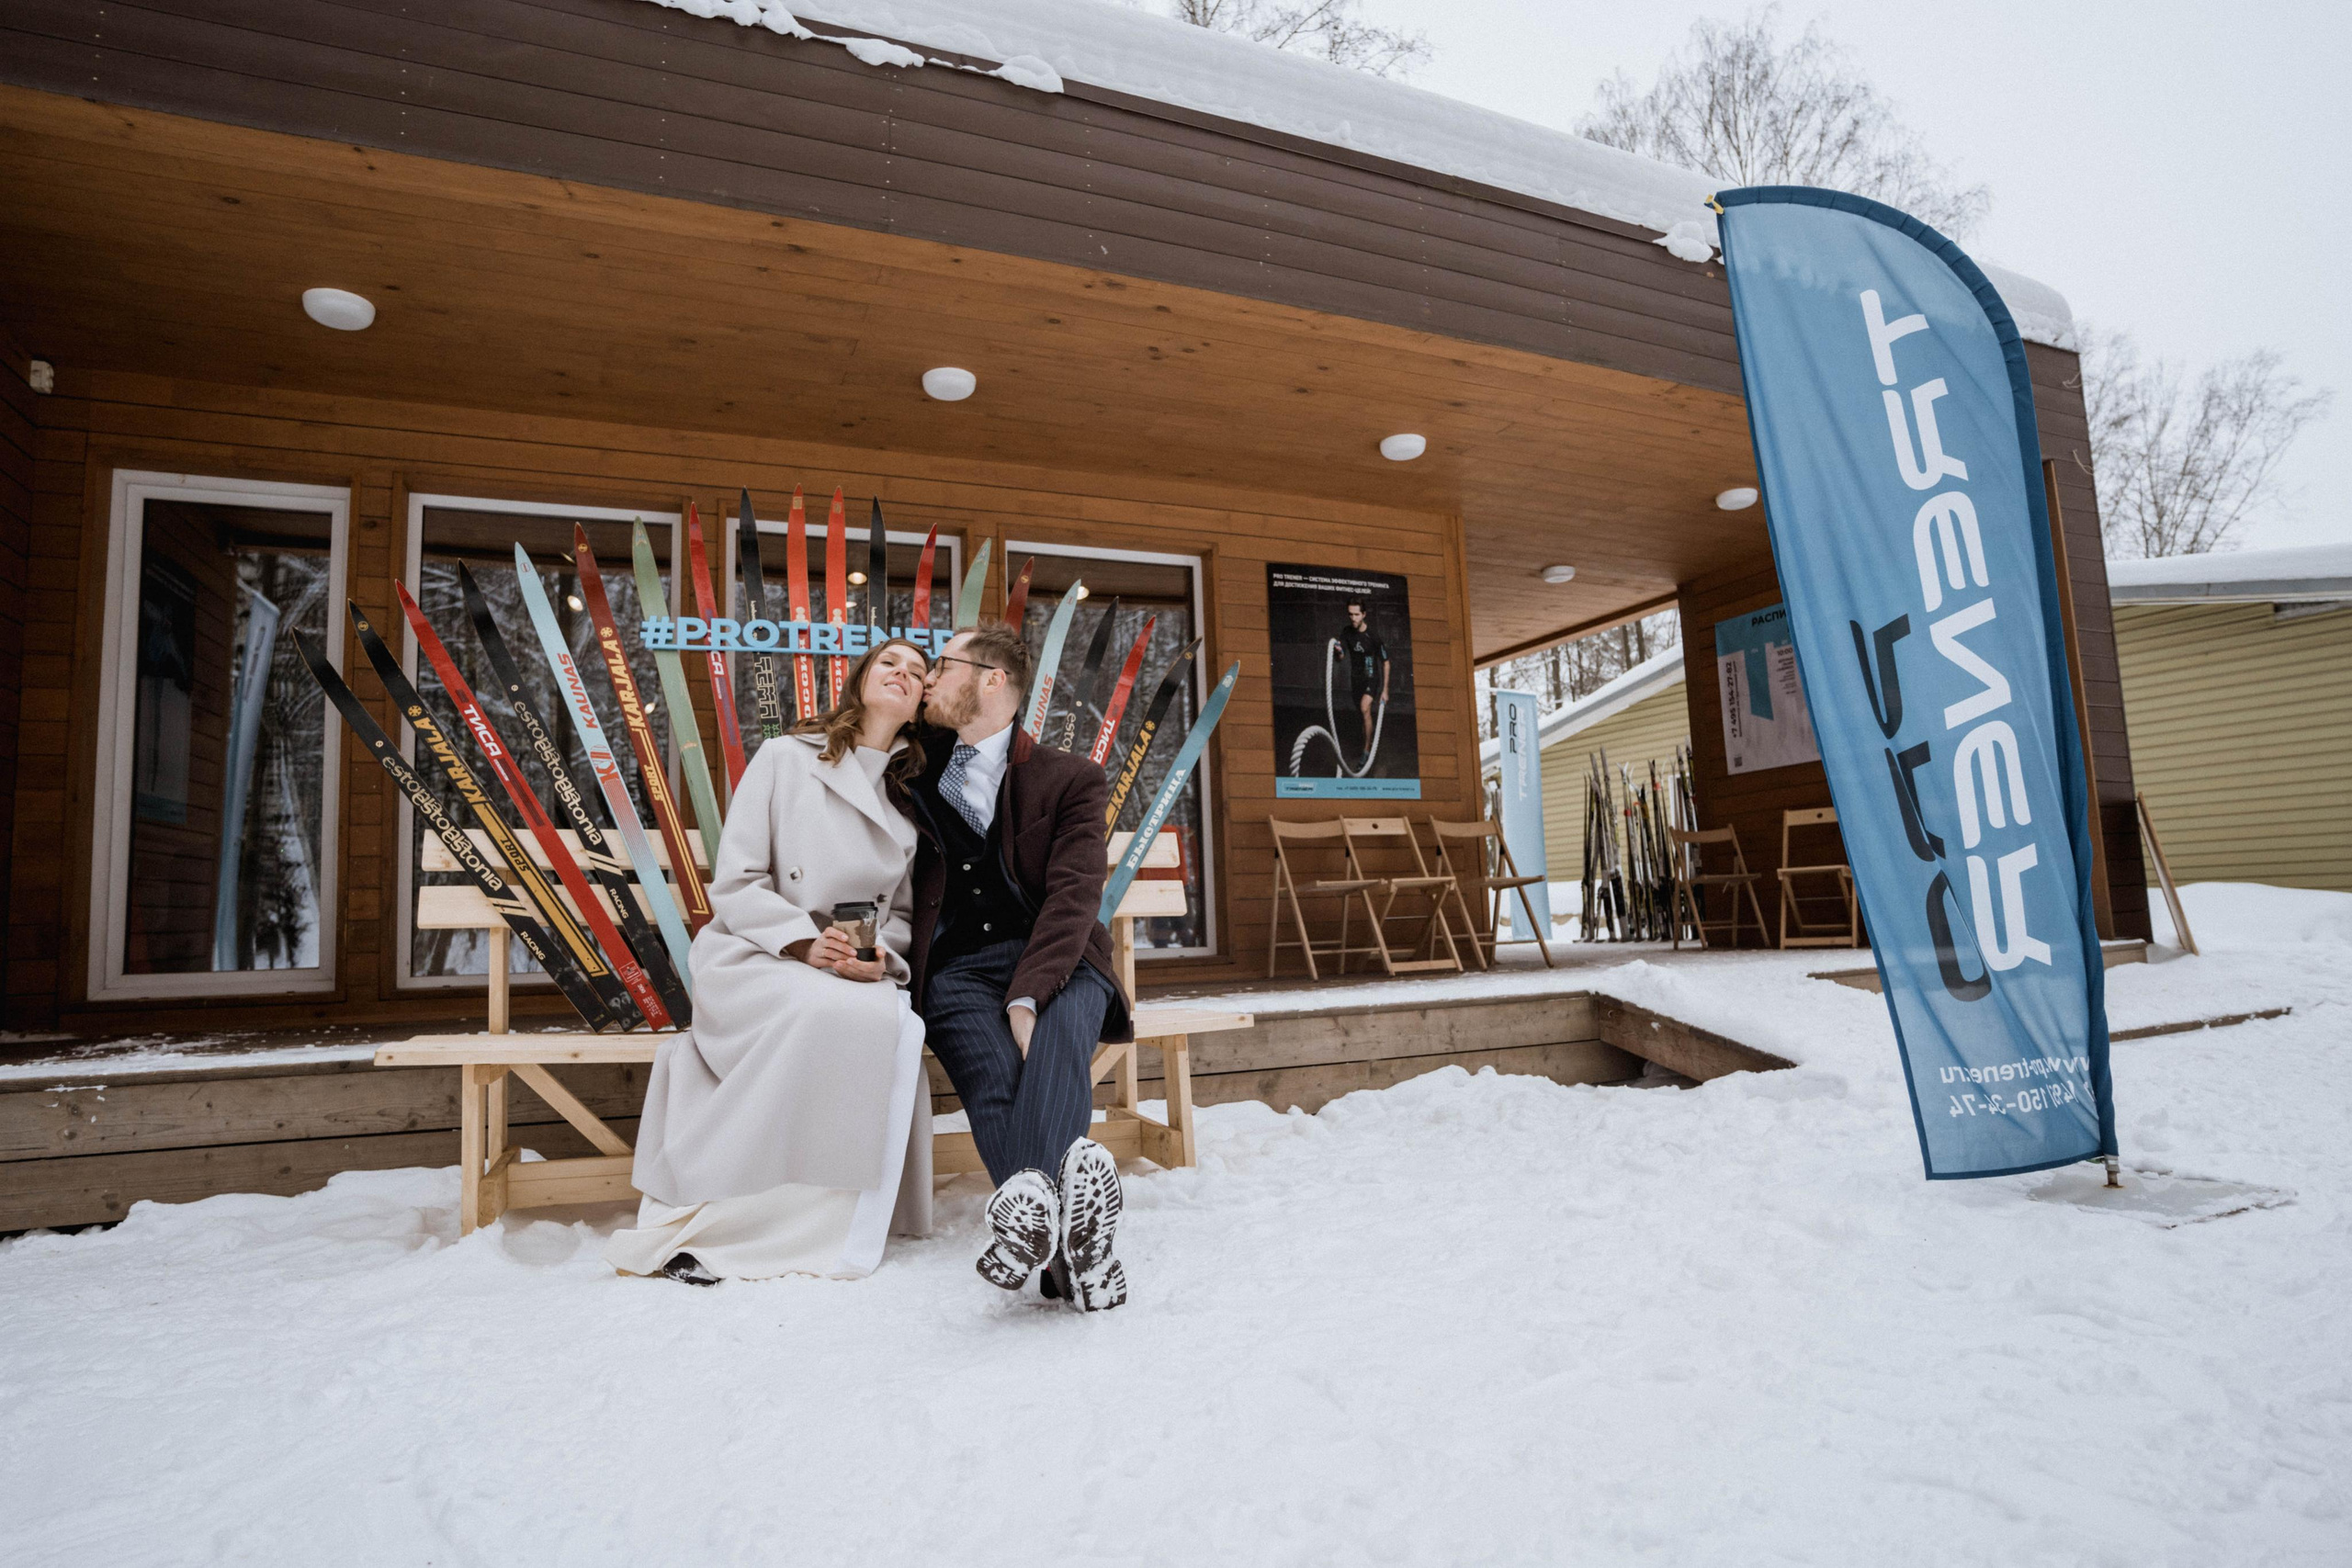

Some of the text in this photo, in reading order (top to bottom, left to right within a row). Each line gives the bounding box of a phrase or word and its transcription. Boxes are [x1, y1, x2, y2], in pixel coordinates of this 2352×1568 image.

[1751, 609, 1787, 626] РАСПИ
[558, 653, 598, 728] KAUNAS
[603, 639, 646, 728] KARJALA
[799, 638, 811, 718] ОССИЯ
[413, 716, 487, 805] KARJALA
[643, 764, 663, 802] SPORT
[1111, 728, 1152, 810] KARJALA
[500, 838, 530, 872] SPORT
[1125, 769, 1186, 871] БЫСТРИЦА
[609, 888, 629, 919] RACING
[520, 931, 546, 961] RACING
